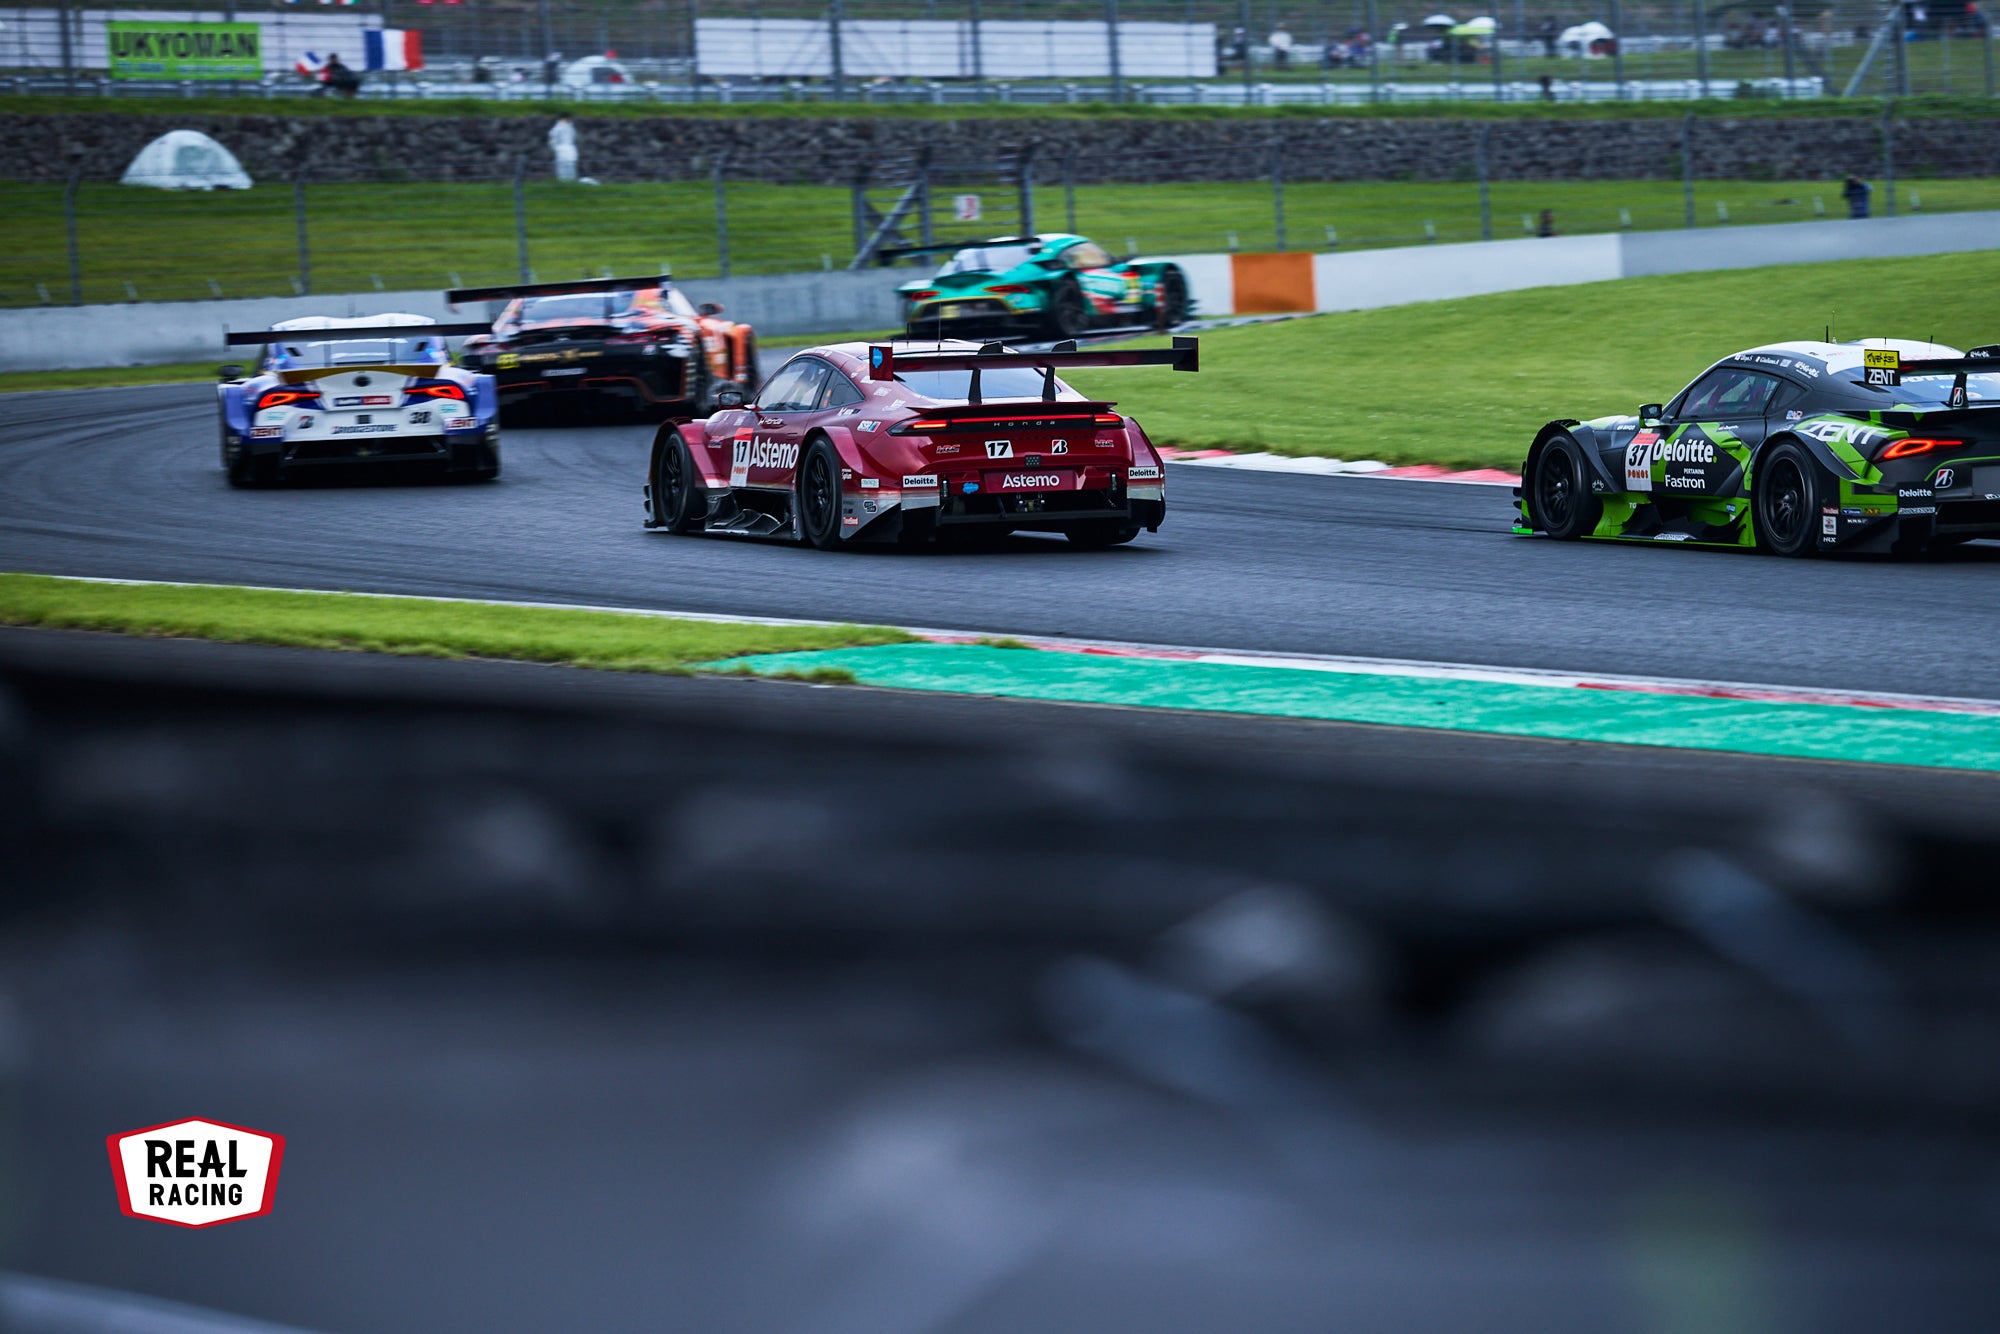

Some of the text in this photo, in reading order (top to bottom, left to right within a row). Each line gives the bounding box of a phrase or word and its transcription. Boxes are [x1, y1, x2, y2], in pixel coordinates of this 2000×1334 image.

[110, 32, 258, 58] UKYOMAN
[1868, 369, 1895, 385] ZENT
[409, 411, 431, 424] 38
[1798, 421, 1882, 444] ZENT
[735, 441, 748, 463] 17
[749, 435, 799, 469] Astemo
[988, 442, 1009, 456] 17
[1628, 444, 1649, 466] 37
[1652, 438, 1718, 464] Deloitte.
[1129, 469, 1158, 477] Deloitte.
[1627, 469, 1649, 479] PONOS
[1683, 467, 1705, 475] PERTAMINA
[904, 477, 937, 485] Deloitte.
[1002, 474, 1060, 488] Astemo
[1664, 474, 1706, 489] Fastron
